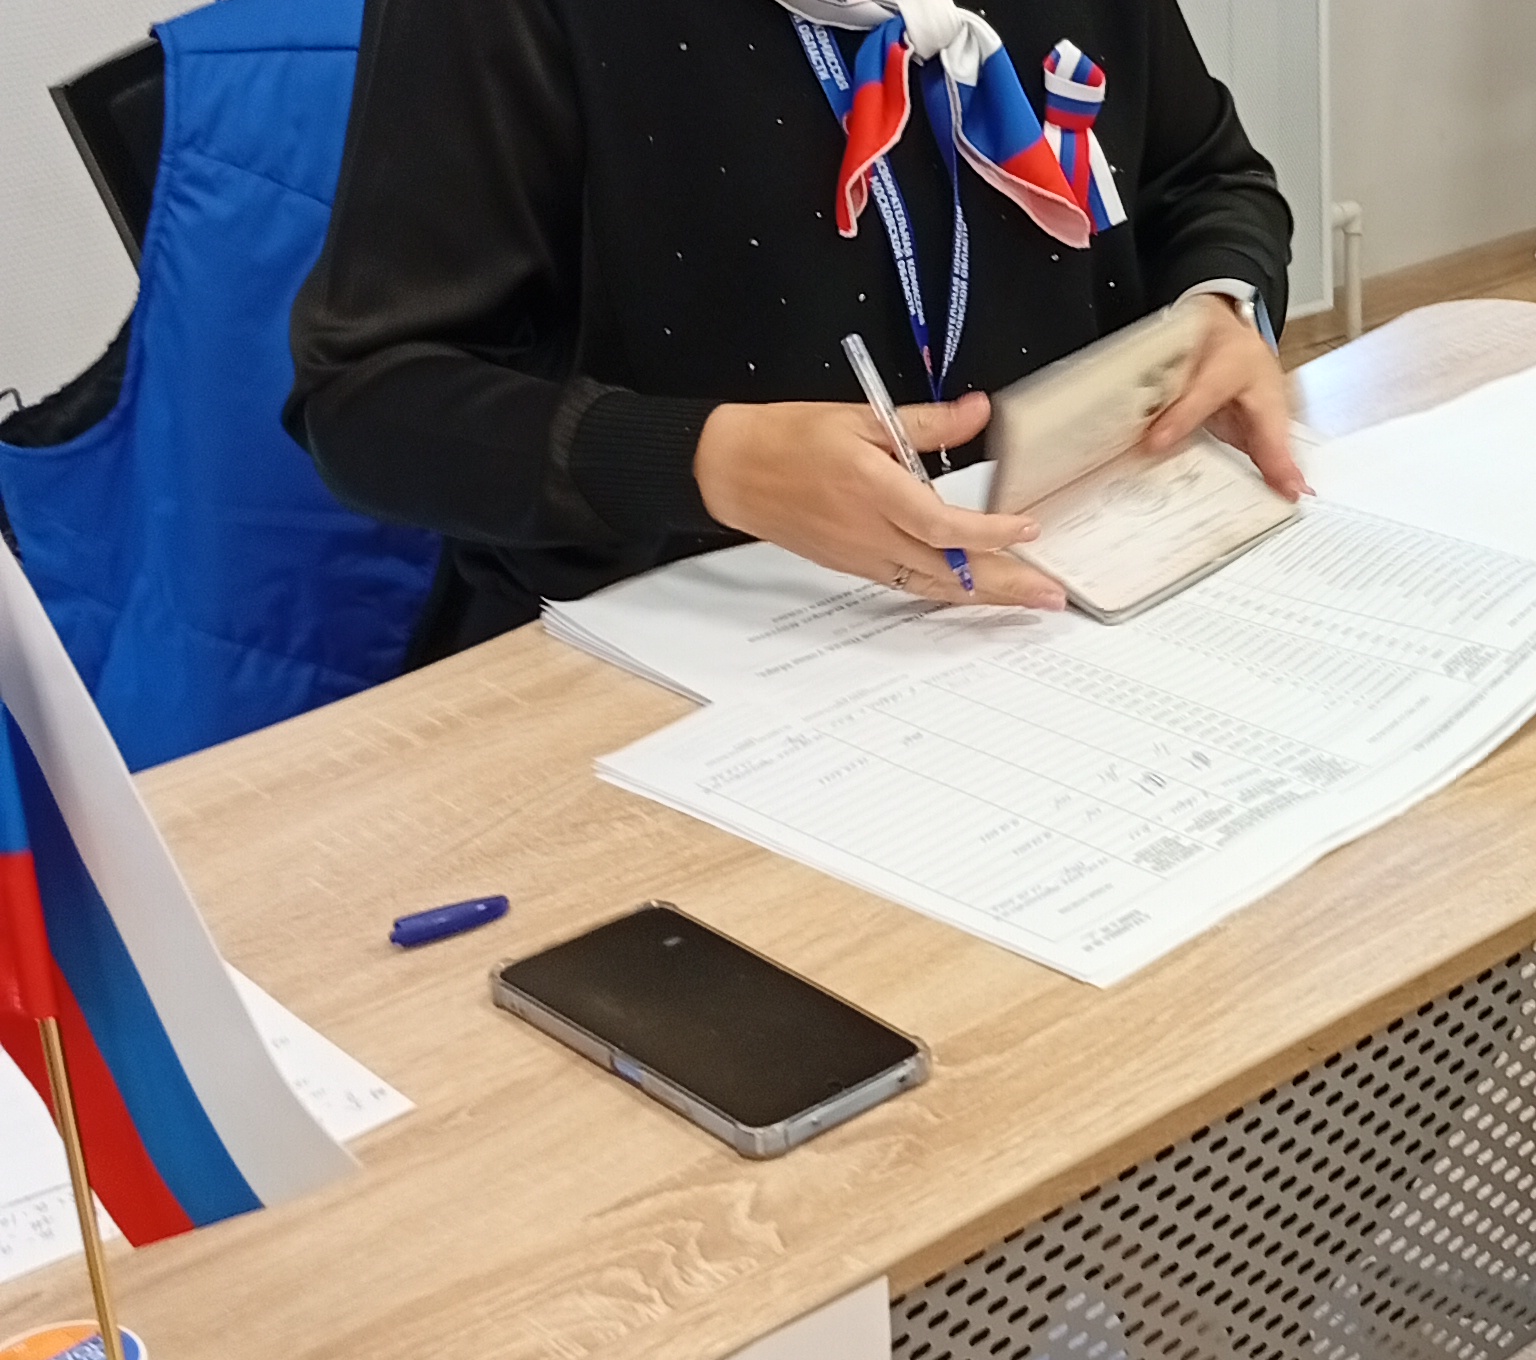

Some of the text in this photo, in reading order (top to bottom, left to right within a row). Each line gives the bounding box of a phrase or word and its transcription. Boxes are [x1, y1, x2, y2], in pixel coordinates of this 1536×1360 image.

[798, 24, 831, 80] ОБЛАСТИ
[897, 259, 917, 317] ОБЛАСТИ
[906, 257, 926, 326] КОМИССИЯ
